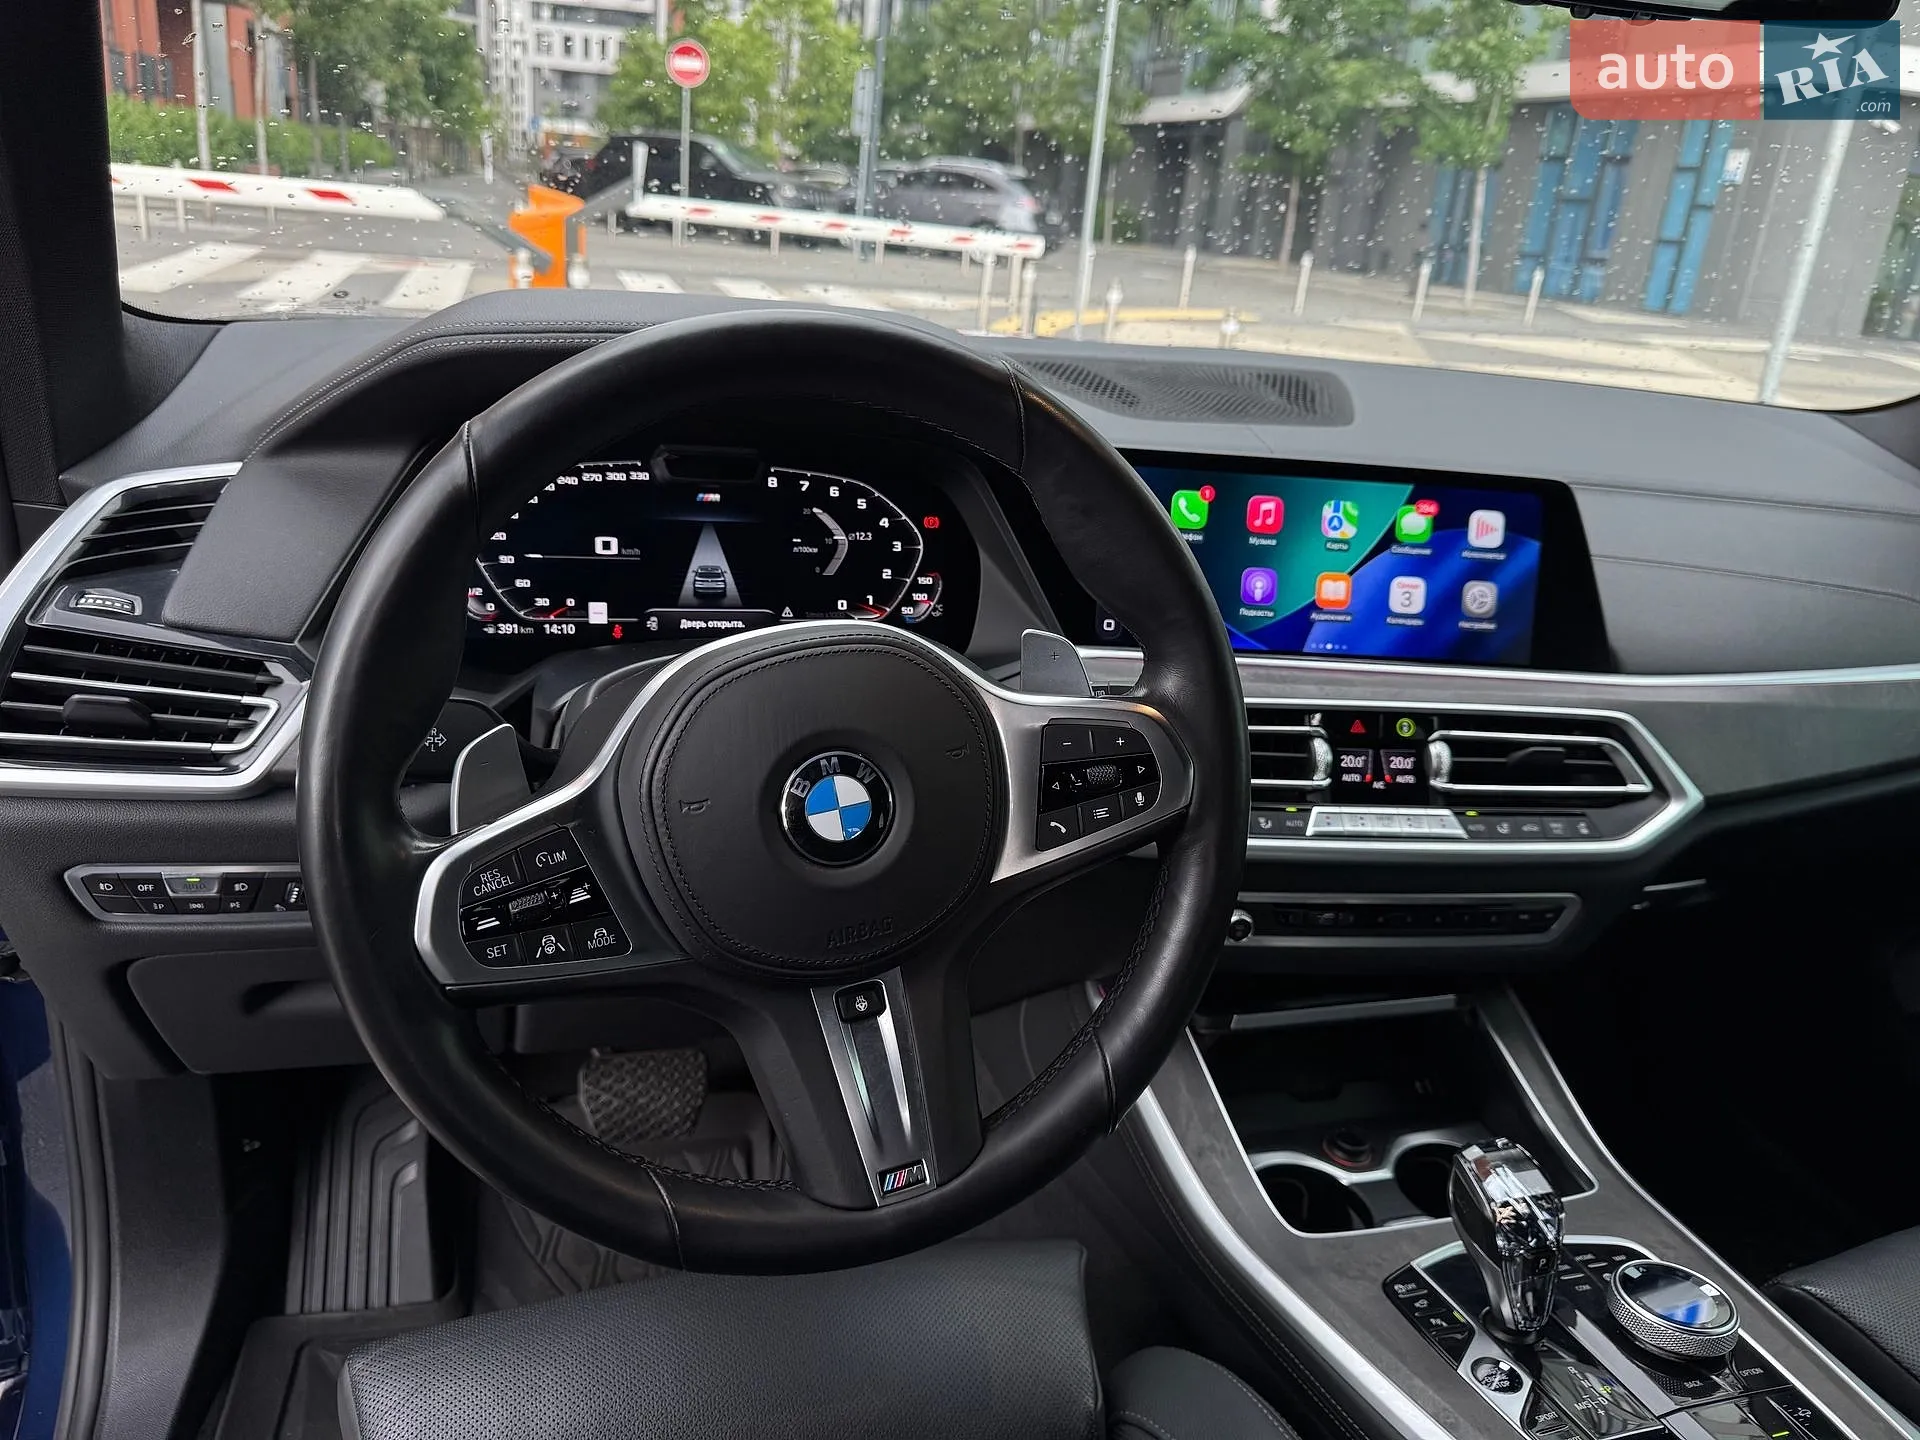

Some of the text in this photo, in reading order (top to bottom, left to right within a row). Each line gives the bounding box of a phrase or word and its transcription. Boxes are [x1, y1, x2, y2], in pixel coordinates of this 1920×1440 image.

[582, 473, 602, 482] 270
[605, 472, 626, 481] 300
[629, 472, 650, 481] 330
[767, 477, 778, 487] 8
[799, 481, 810, 491] 7
[829, 486, 840, 497] 6
[857, 498, 867, 509] 5
[879, 517, 889, 528] 4
[490, 532, 507, 541] 20
[594, 536, 618, 554] 0
[892, 542, 902, 552] 3
[498, 555, 515, 564] 90
[882, 569, 892, 579] 2
[515, 579, 531, 588] 60
[534, 598, 550, 606] 30
[866, 595, 874, 606] 1
[912, 593, 928, 601] 100
[1400, 591, 1413, 608] 3
[485, 602, 495, 611] 0
[566, 598, 575, 607] 0
[837, 599, 848, 610] 0
[901, 606, 914, 614] 50
[497, 623, 518, 634] 391
[543, 623, 576, 634] 14:10
[680, 619, 707, 629] Дверь
[790, 756, 877, 798] BMW
[549, 850, 568, 865] LIM
[480, 868, 501, 883] RES
[138, 884, 155, 892] OFF
[473, 874, 515, 897] CANCEL
[587, 934, 617, 950] MODE
[486, 943, 508, 959] SET
[1739, 1367, 1764, 1377] OPTION
[1535, 1411, 1558, 1422] SPORT
